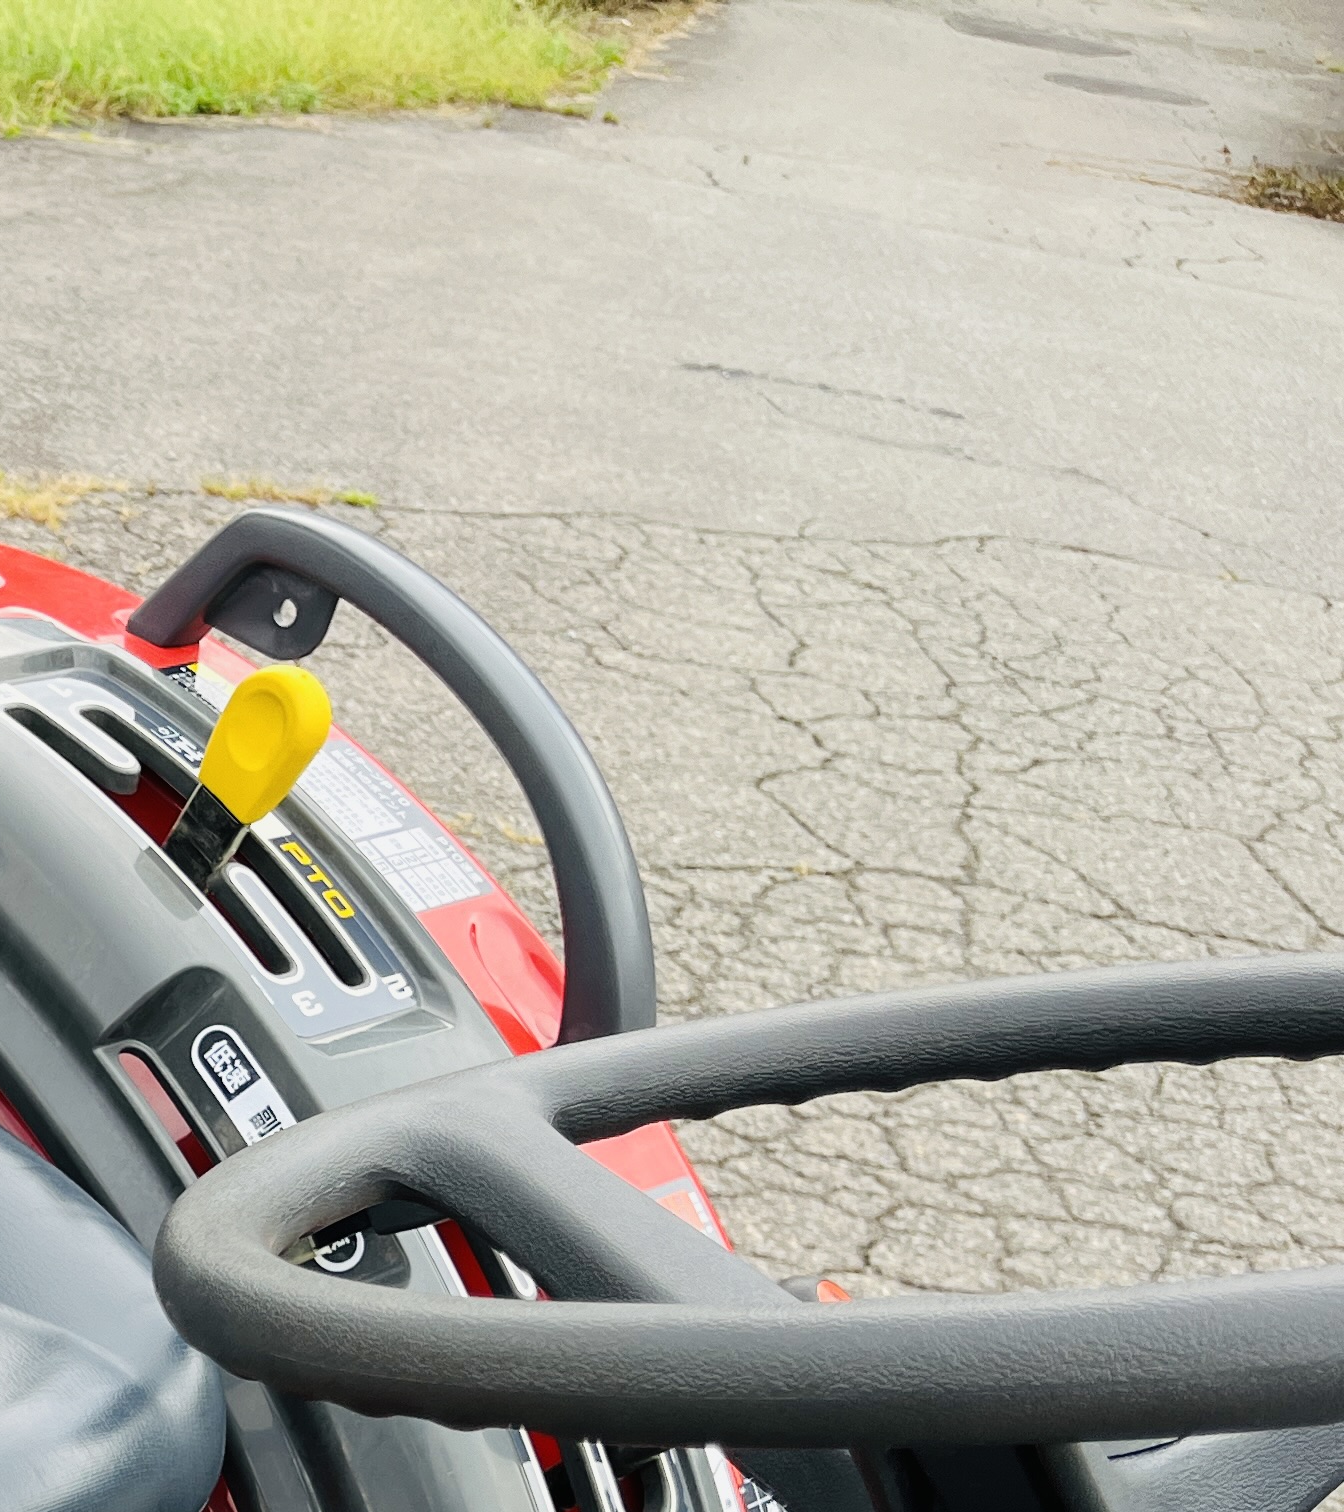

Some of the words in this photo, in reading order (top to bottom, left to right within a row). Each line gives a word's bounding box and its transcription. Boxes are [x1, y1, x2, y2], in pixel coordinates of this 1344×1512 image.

[279, 840, 354, 919] PTO
[292, 989, 324, 1017] 3
[201, 1036, 252, 1095] 低速
